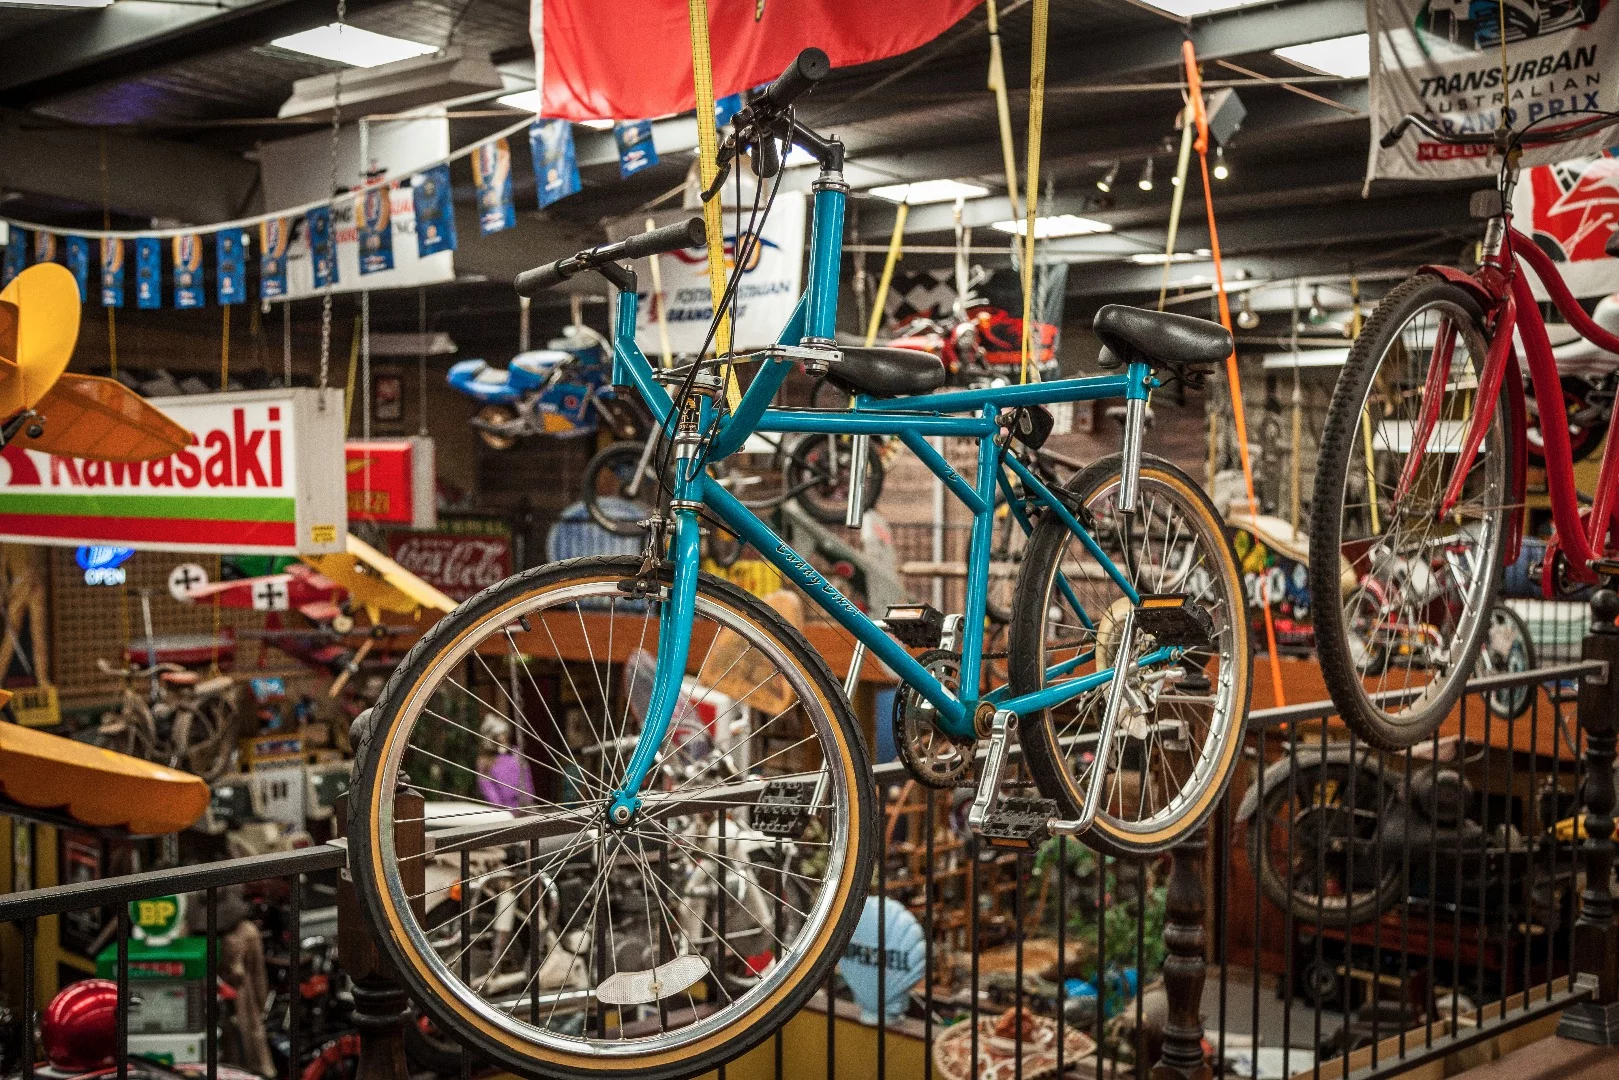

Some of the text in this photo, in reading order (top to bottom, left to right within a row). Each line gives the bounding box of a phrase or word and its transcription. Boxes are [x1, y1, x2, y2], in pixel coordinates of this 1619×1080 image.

[1419, 44, 1597, 98] TRANSURBAN
[1423, 72, 1600, 114] AUSTRALIAN
[1528, 91, 1600, 123] PRIX
[84, 566, 126, 586] OPEN
[137, 901, 176, 927] BP
